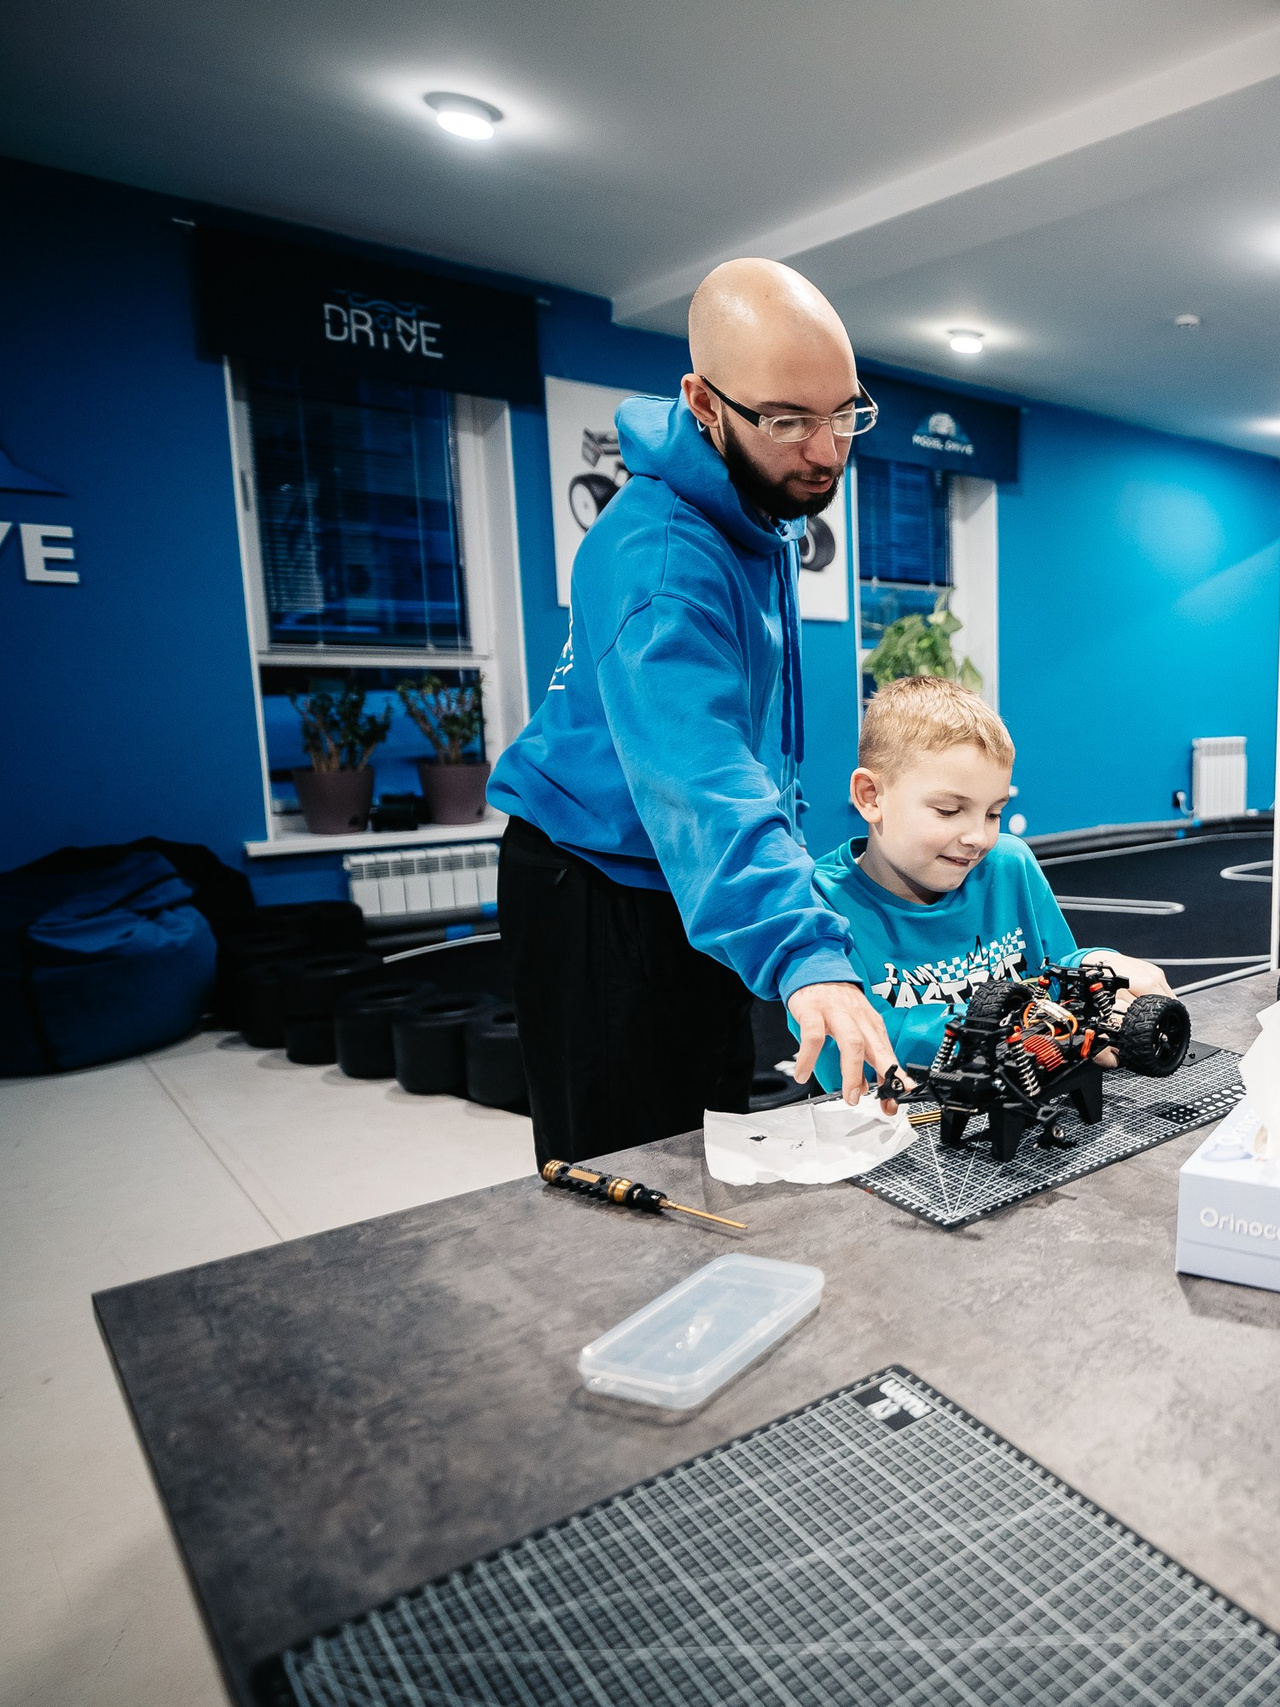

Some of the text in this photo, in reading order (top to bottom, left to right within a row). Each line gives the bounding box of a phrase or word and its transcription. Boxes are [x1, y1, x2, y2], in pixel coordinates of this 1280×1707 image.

[0, 521, 80, 583] E
[884, 962, 939, 986] I AM
